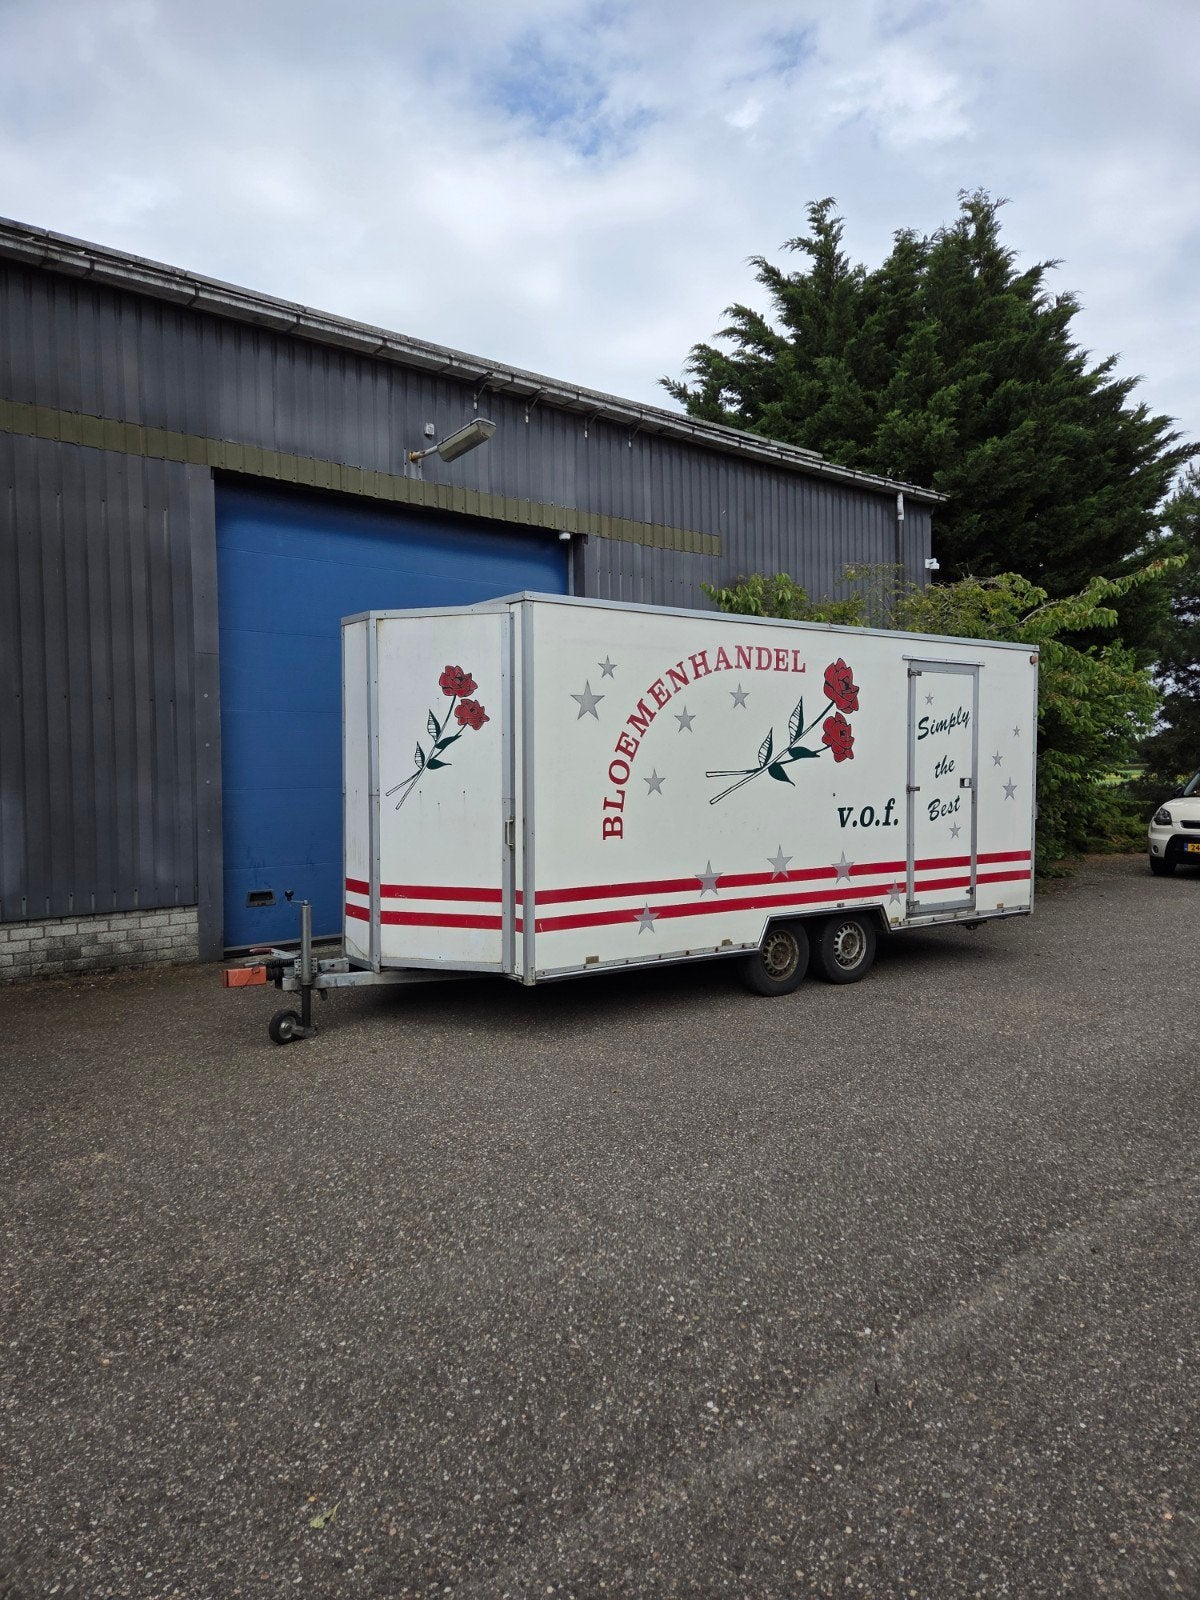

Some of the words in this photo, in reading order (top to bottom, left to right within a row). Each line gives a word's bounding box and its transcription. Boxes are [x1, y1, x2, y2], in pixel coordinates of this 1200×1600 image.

[917, 706, 970, 740] Simply
[602, 645, 806, 840] BLOEMENHANDEL
[934, 755, 955, 779] the
[837, 797, 899, 828] v.o.f.
[927, 795, 961, 822] Best
